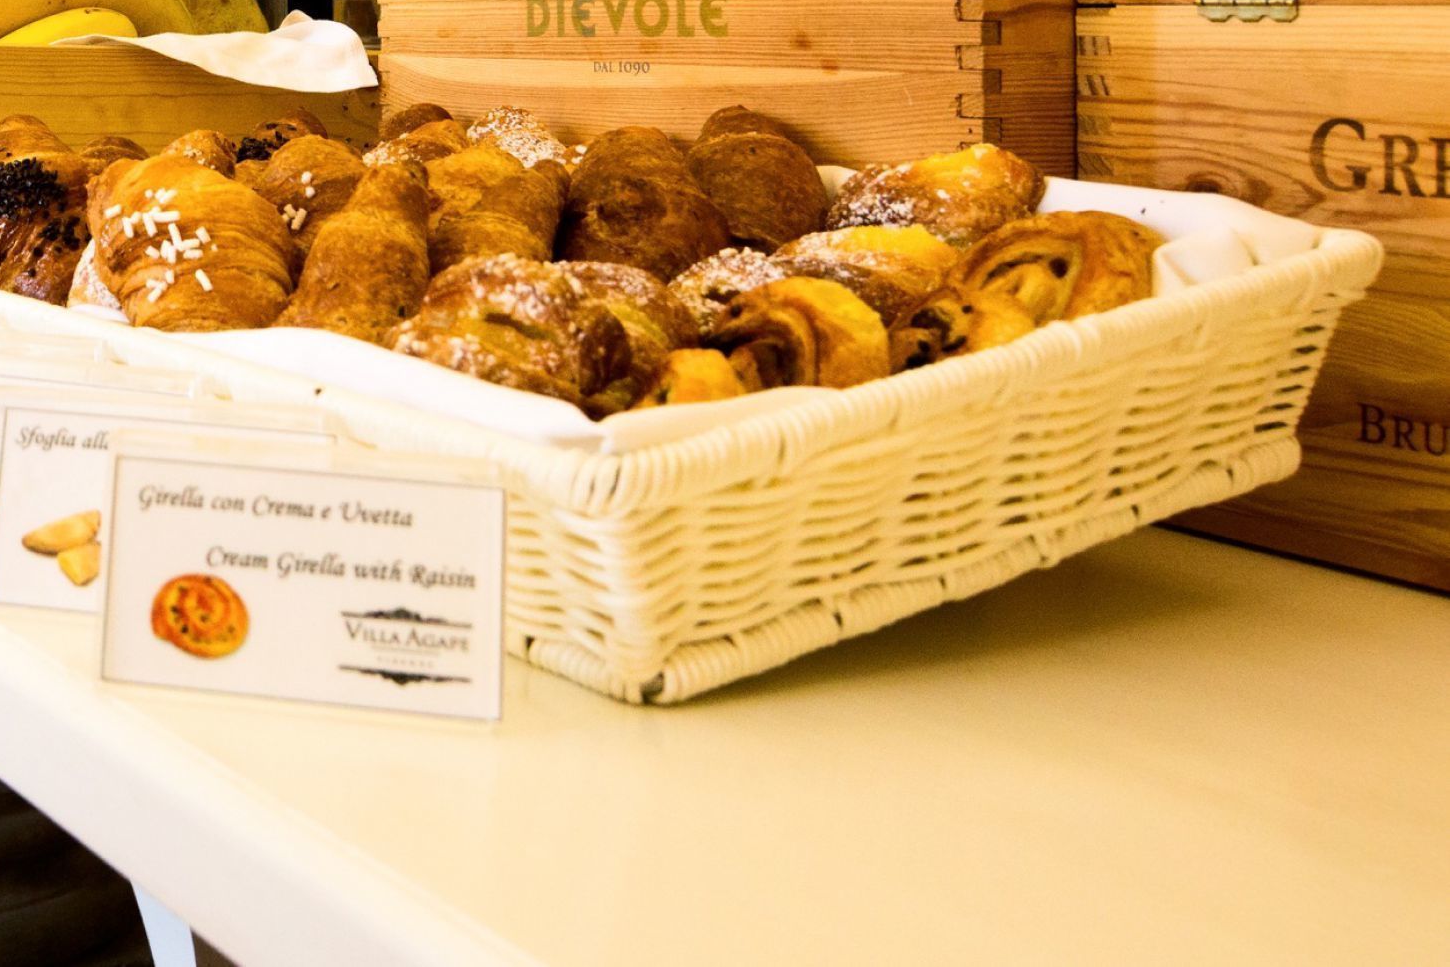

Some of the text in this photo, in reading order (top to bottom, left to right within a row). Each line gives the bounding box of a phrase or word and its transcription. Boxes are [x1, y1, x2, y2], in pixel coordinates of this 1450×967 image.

[594, 61, 651, 76] DAL 1090
[15, 425, 77, 451] Sfoglia
[1356, 401, 1450, 457] BRU
[139, 484, 415, 528] Girella con Crema e Uvetta
[206, 545, 477, 590] Cream Girella with Raisin
[345, 620, 400, 646] VILLA
